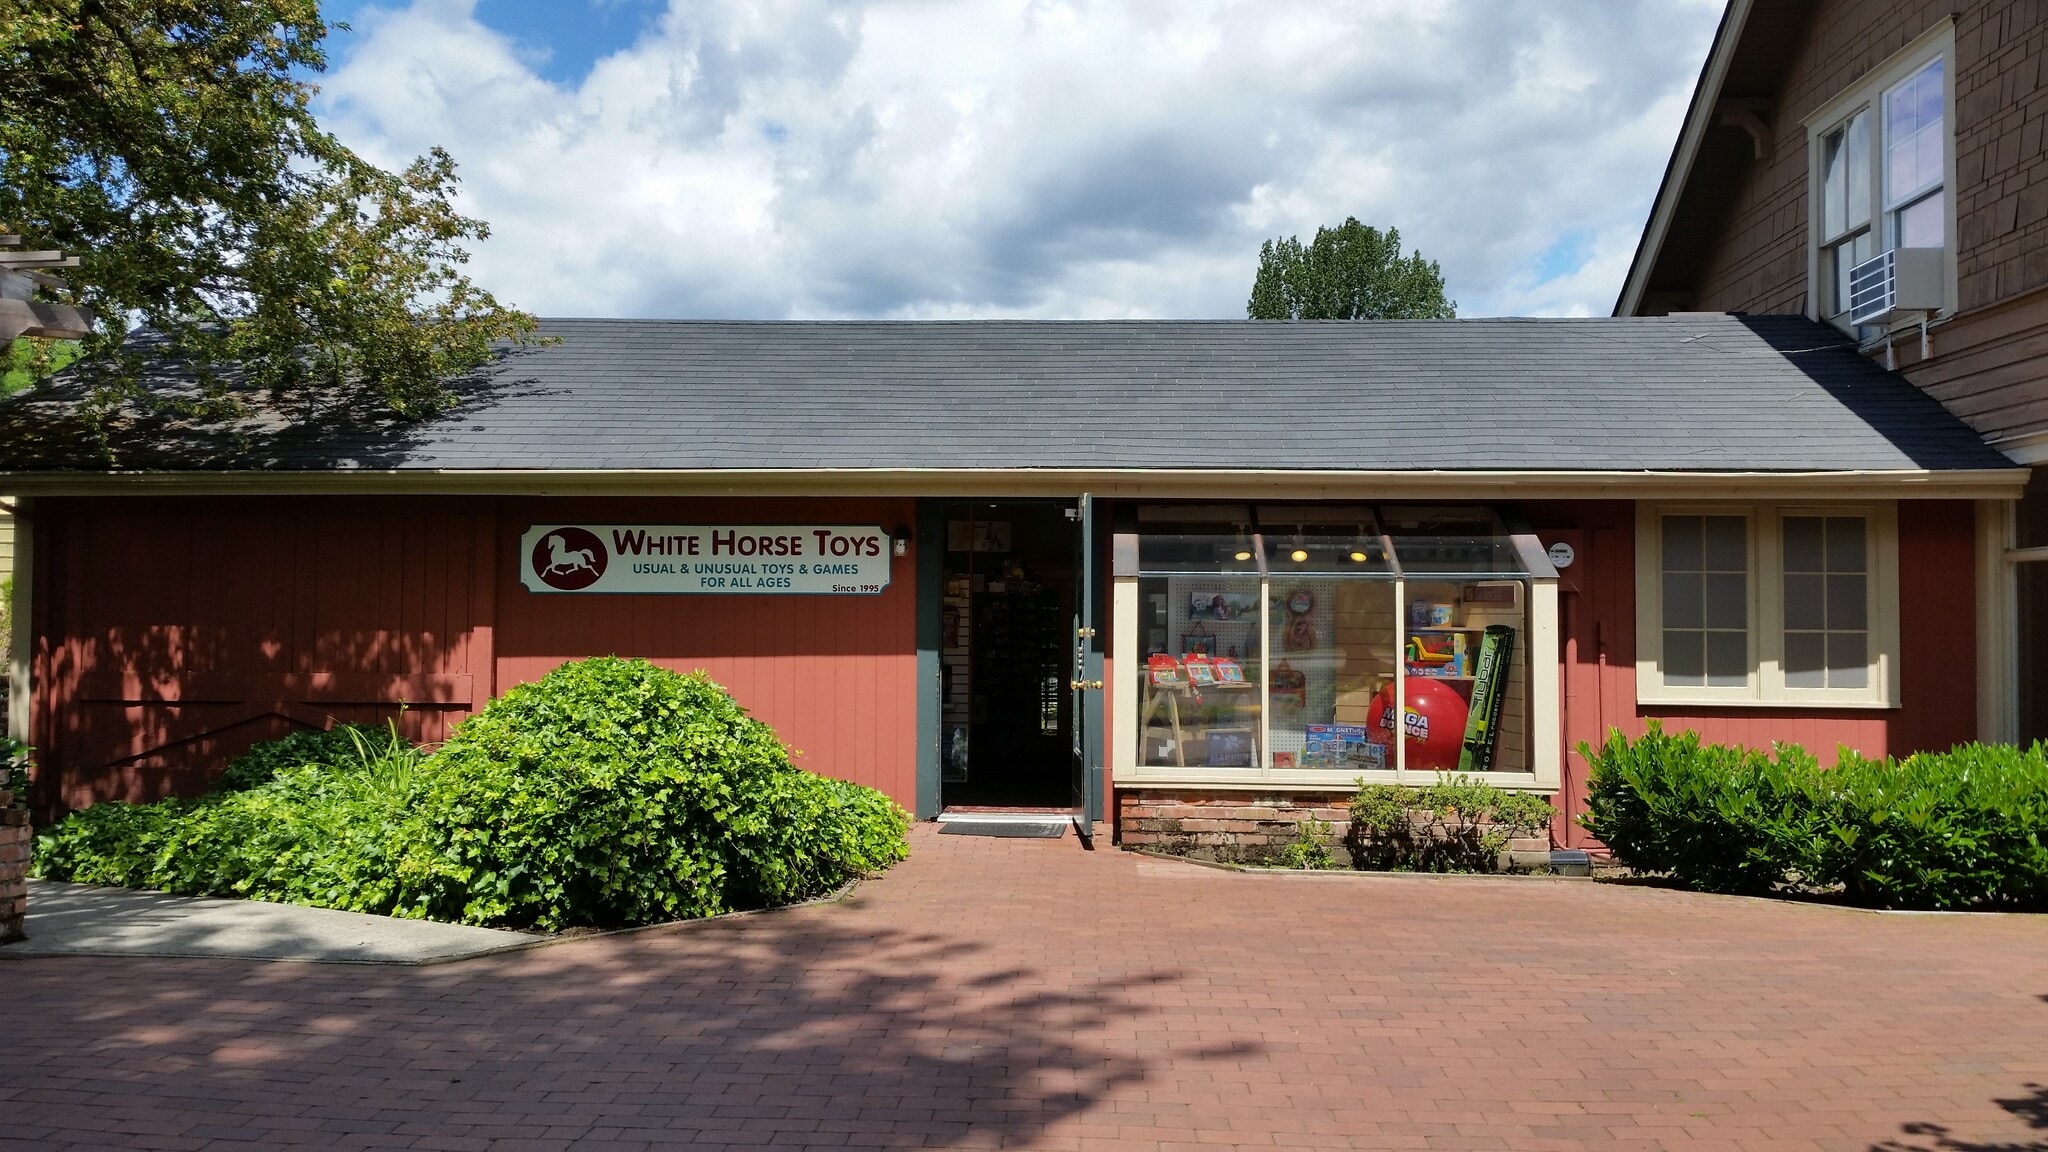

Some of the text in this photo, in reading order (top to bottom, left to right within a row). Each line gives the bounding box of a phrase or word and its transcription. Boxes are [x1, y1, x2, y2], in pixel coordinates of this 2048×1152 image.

[612, 529, 880, 557] WHITE HORSE TOYS
[633, 563, 859, 575] USUAL & UNUSUAL TOYS & GAMES
[700, 577, 791, 588] FOR ALL AGES
[832, 584, 879, 593] Since 1995
[1379, 717, 1429, 739] BONCE
[1382, 707, 1429, 729] MGA
[1482, 731, 1494, 771] ROPEL
